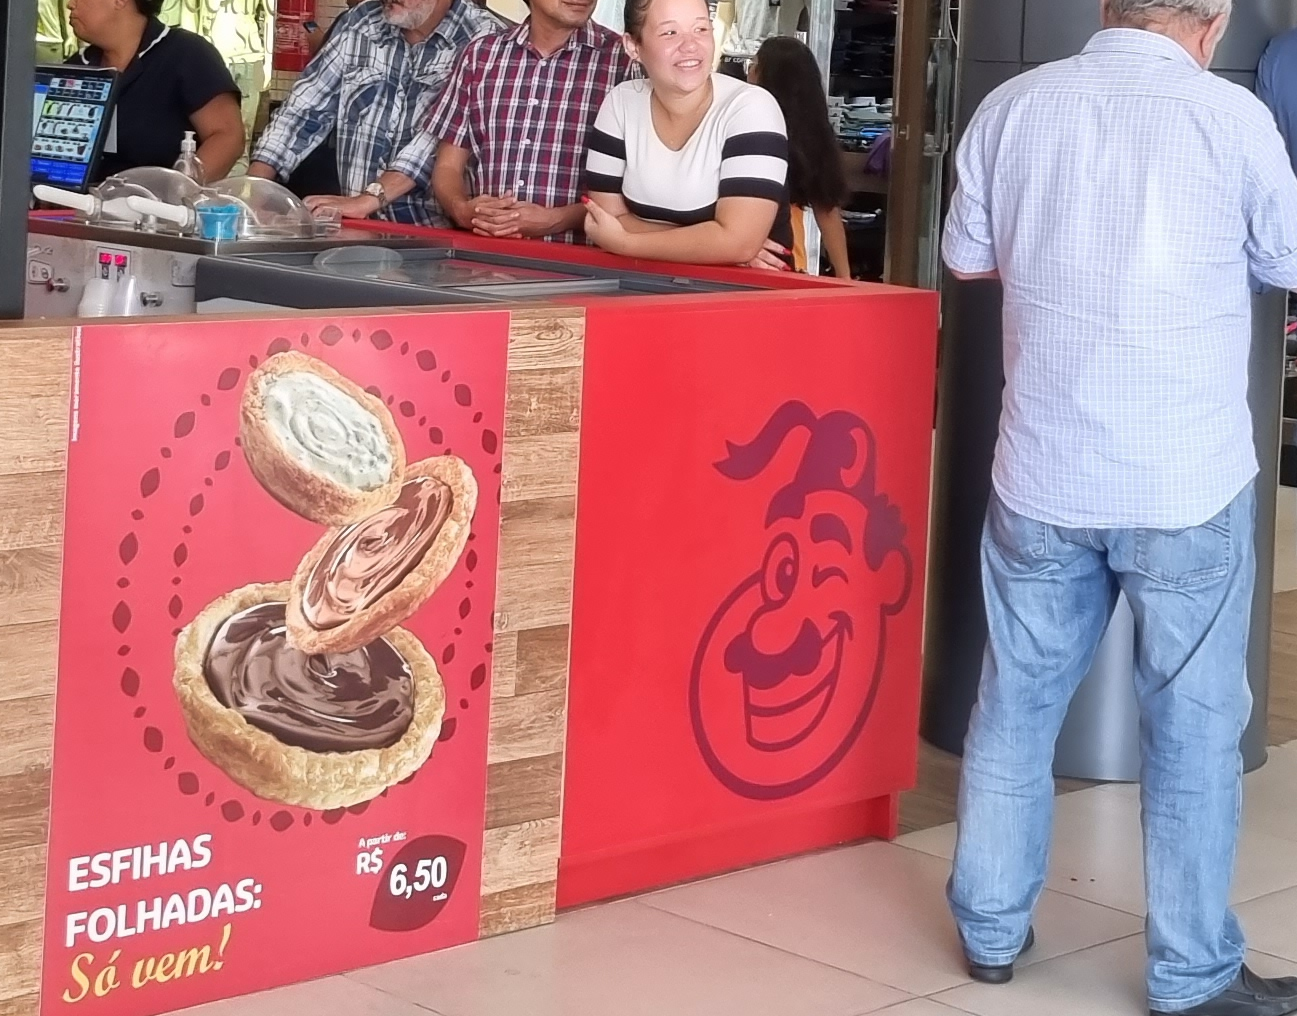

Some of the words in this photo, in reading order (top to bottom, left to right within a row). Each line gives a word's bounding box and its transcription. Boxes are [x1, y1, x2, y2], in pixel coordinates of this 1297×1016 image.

[68, 833, 212, 892] ESFIHAS
[358, 838, 366, 848] A
[366, 833, 392, 849] partir
[356, 847, 384, 875] R$
[389, 856, 448, 900] 6,50
[65, 878, 263, 948] FOLHADAS:
[62, 949, 122, 1003] Só
[131, 922, 232, 989] vem!
